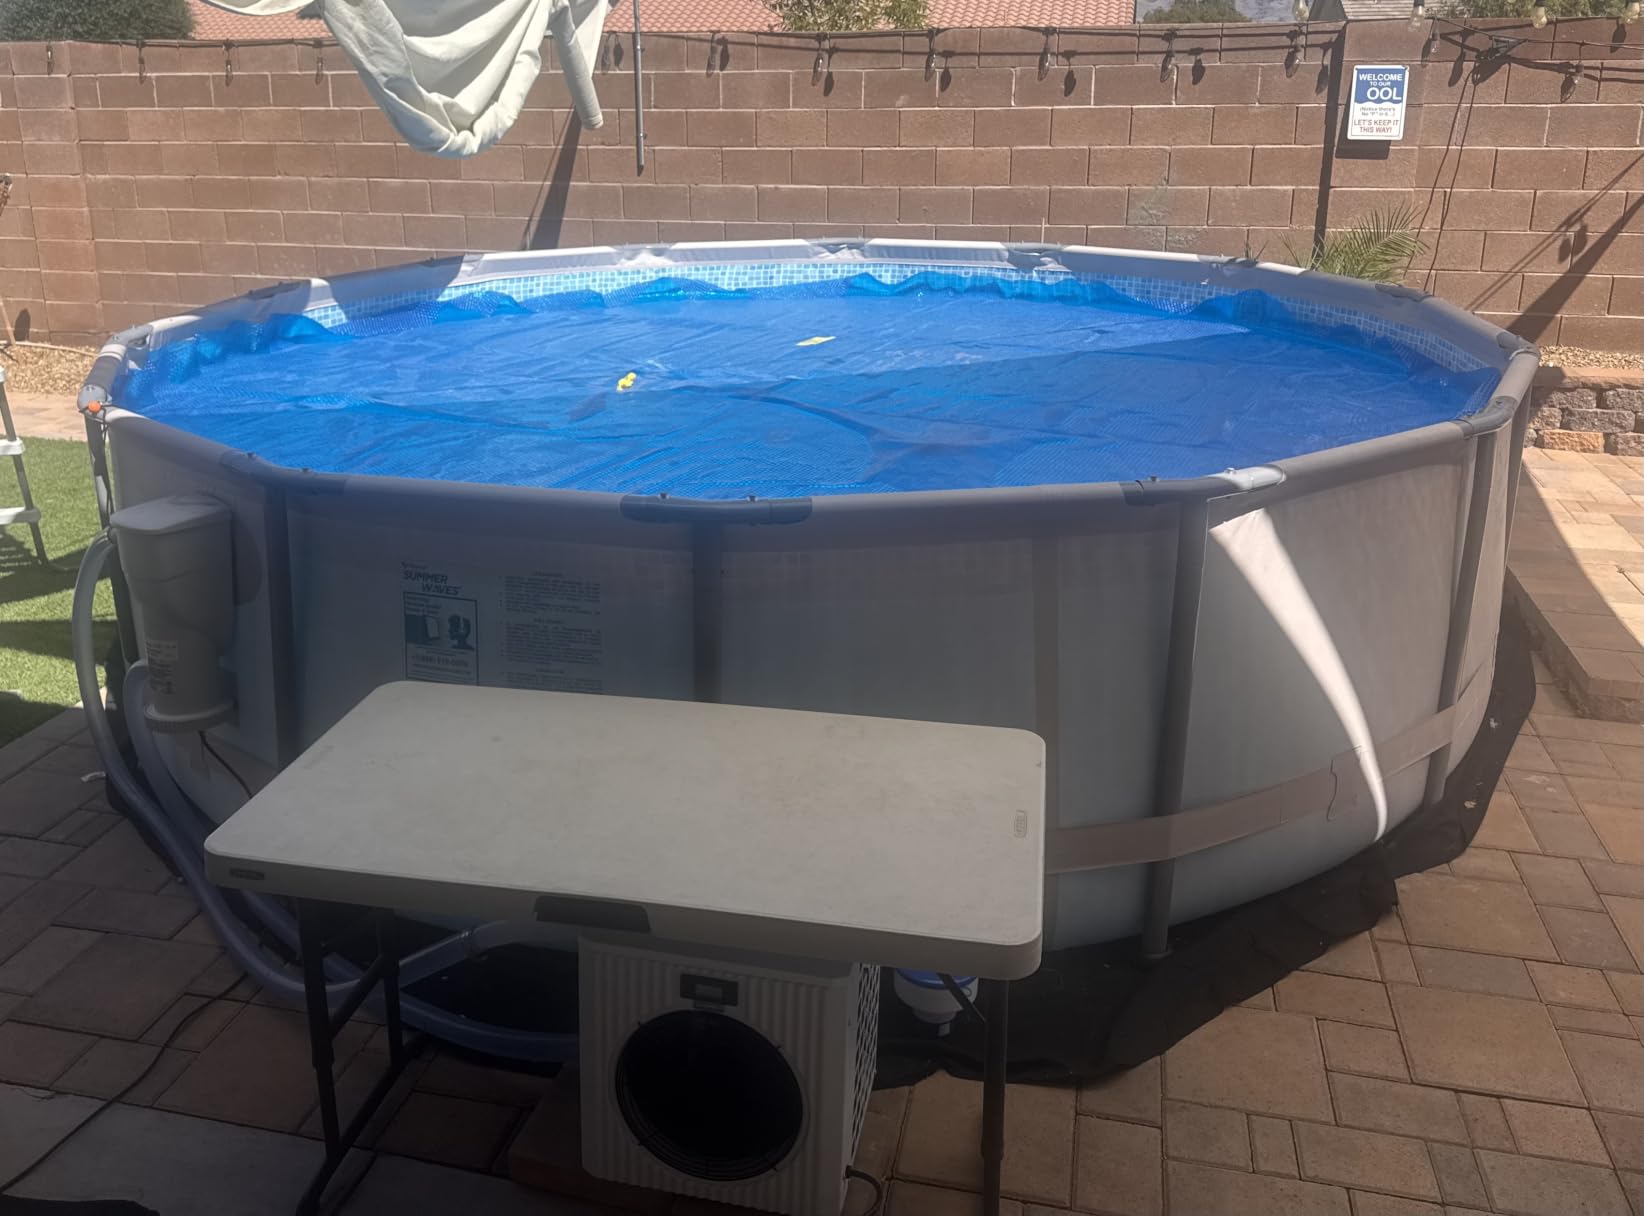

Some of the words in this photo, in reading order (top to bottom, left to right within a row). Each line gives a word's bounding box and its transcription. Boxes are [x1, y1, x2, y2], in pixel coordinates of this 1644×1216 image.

[1359, 73, 1403, 81] WELCOME
[1366, 87, 1402, 100] OOL
[402, 569, 449, 584] SUMMER
[421, 583, 462, 597] WAVES
